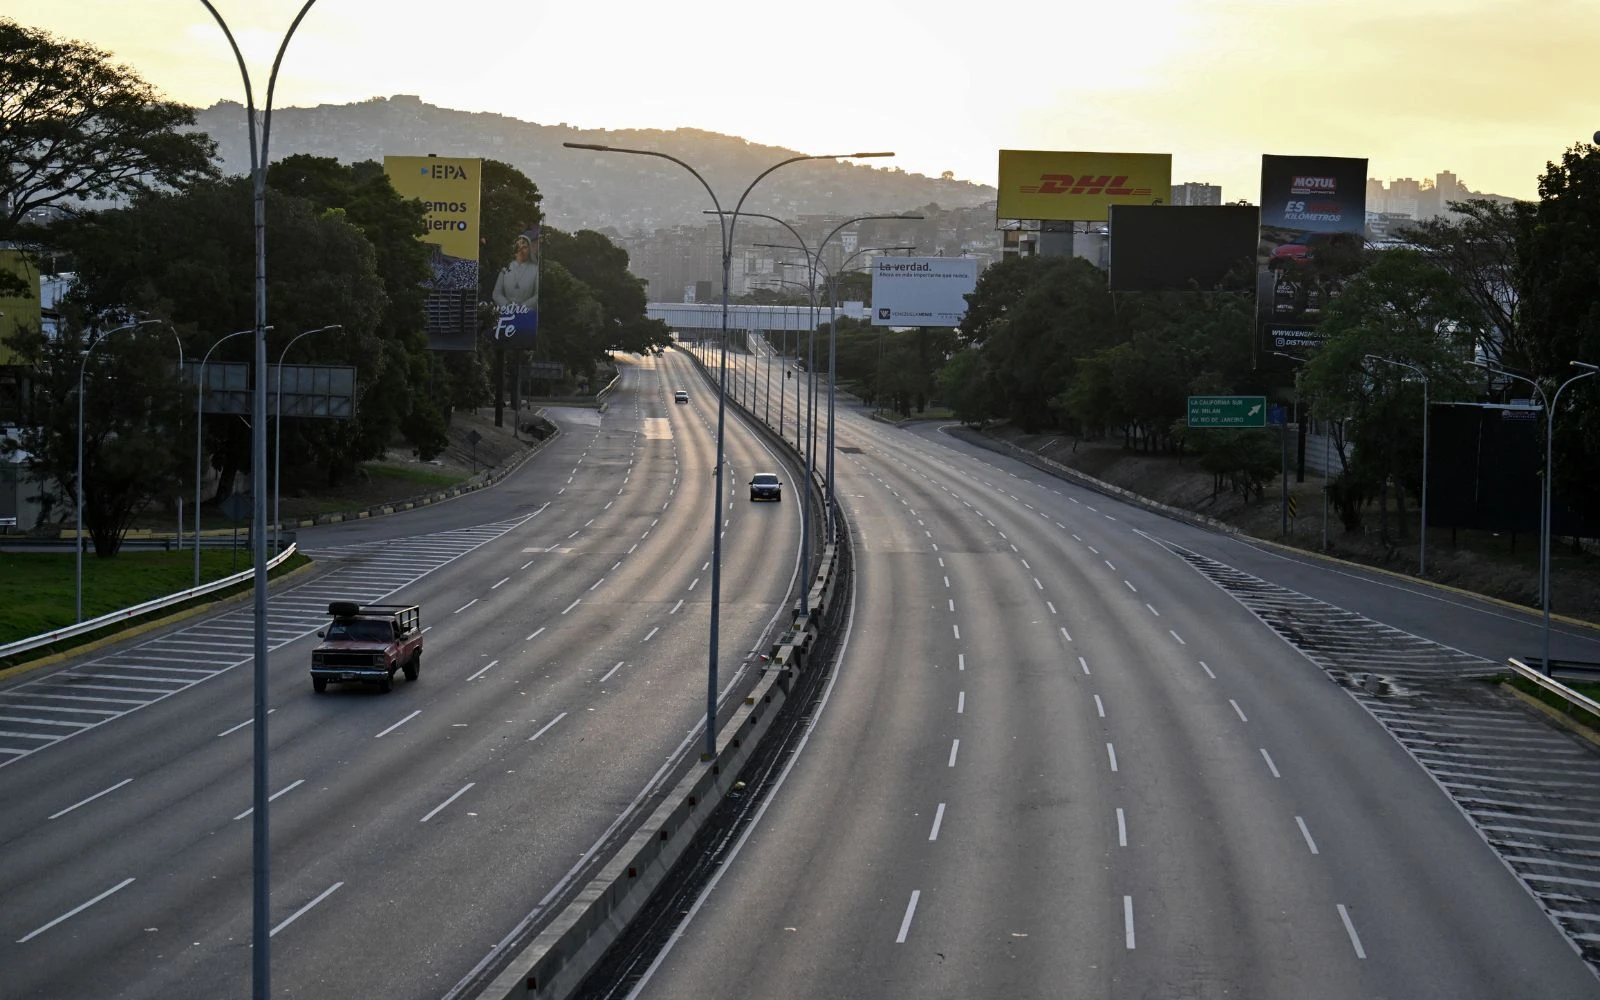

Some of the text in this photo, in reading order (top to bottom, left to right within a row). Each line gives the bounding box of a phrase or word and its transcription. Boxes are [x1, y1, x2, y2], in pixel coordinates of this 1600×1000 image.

[432, 164, 467, 180] EPA
[1038, 174, 1134, 195] DHL
[1294, 177, 1335, 188] MOTUL
[424, 201, 467, 213] emos
[1284, 201, 1305, 213] ES
[1284, 212, 1341, 222] KILÓMETROS
[880, 262, 932, 272] La verdad.
[493, 314, 517, 340] Fe
